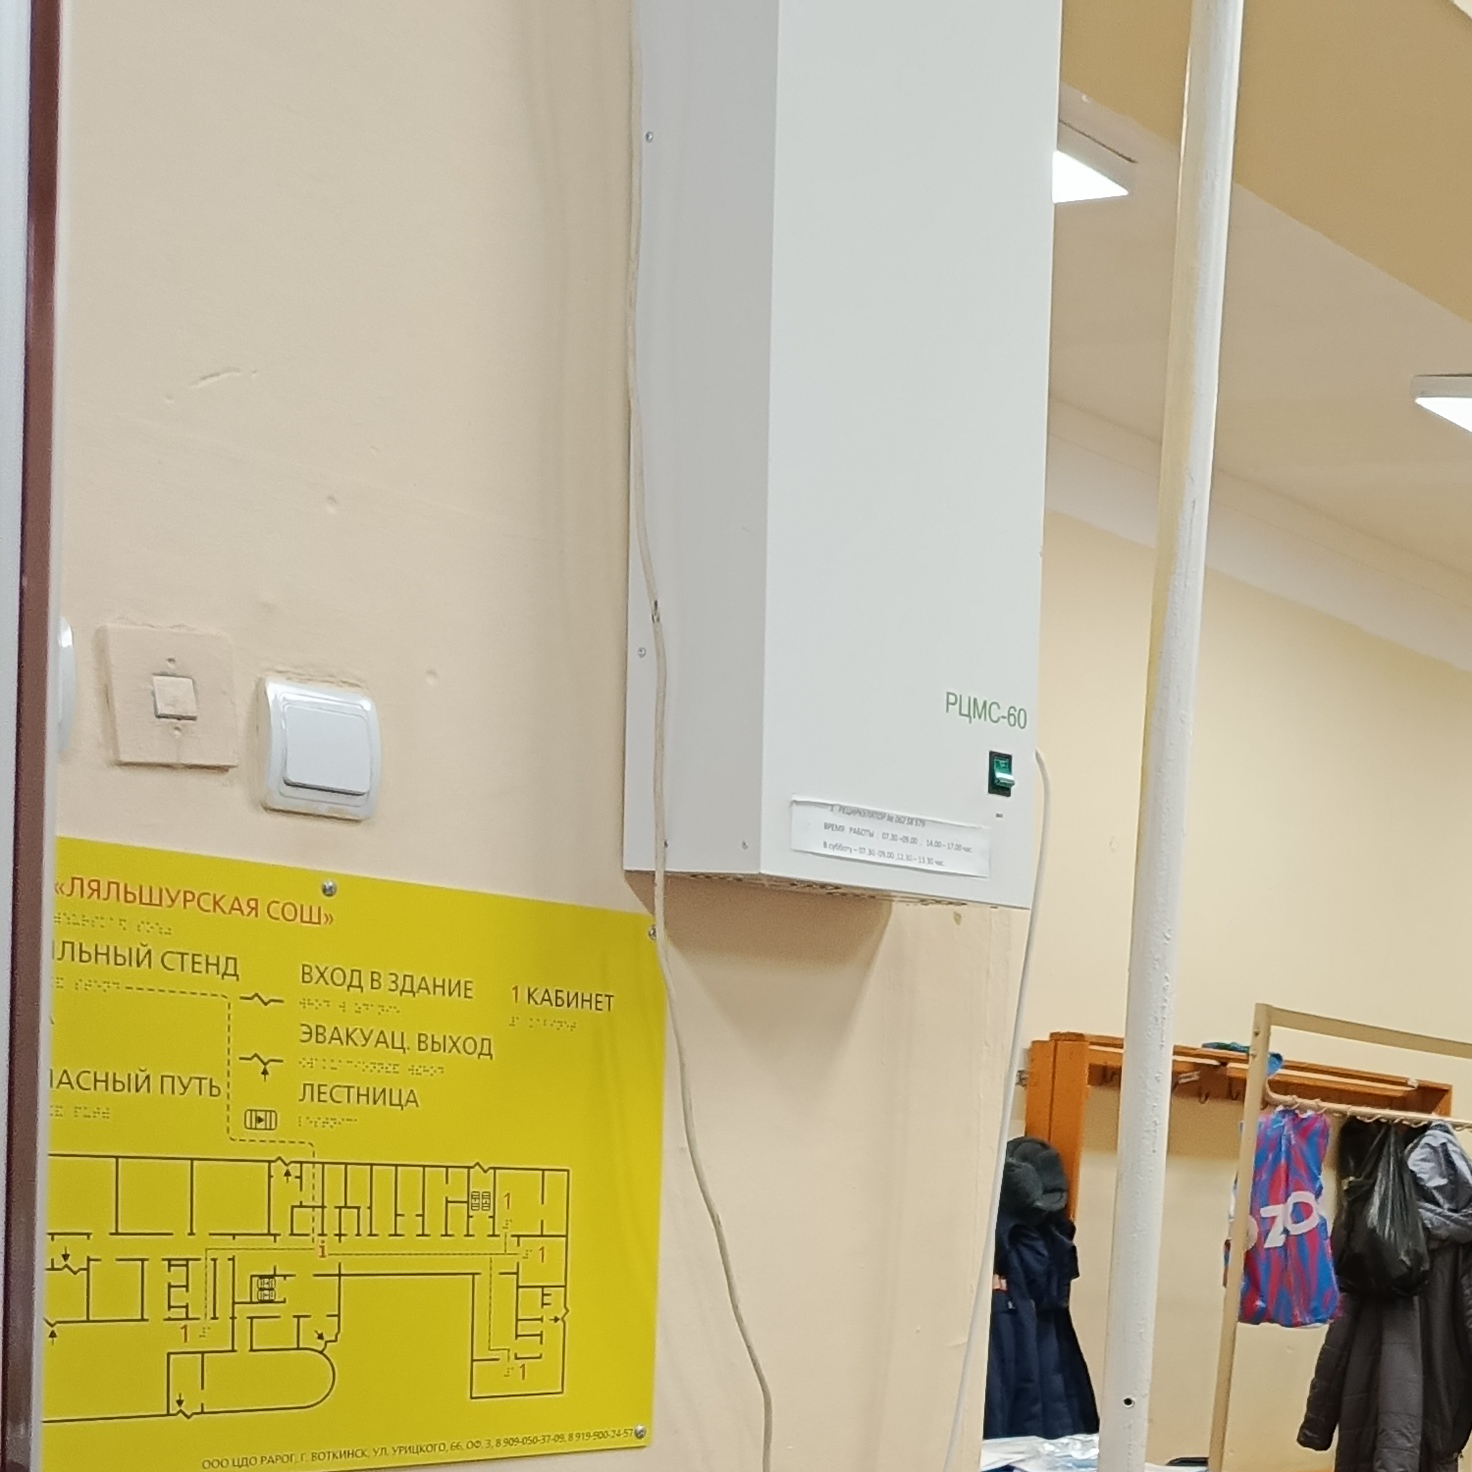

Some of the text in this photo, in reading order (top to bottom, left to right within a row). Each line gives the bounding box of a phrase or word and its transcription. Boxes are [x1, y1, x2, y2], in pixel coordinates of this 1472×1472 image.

[945, 691, 1028, 729] РЦМС-60
[823, 822, 845, 832] ВРЕМЯ
[849, 826, 874, 837] РАБОТЫ
[54, 876, 334, 926] «ЛЯЛЬШУРСКАЯ СОШ»
[51, 940, 240, 981] ЛЬНЫЙ СТЕНД
[300, 963, 474, 1000] ВХОД В ЗДАНИЕ
[511, 985, 615, 1012] 1 КАБИНЕТ
[299, 1023, 494, 1060] ЭВАКУАЦ. ВЫХОД
[50, 1067, 222, 1098] АСНЫЙ ПУТЬ
[298, 1083, 419, 1110] ЛЕСТНИЦА
[503, 1192, 512, 1210] 1
[538, 1246, 547, 1264] 1
[180, 1324, 189, 1343] 1
[519, 1364, 528, 1380] 1
[202, 1458, 229, 1470] ООО
[232, 1456, 258, 1469] ЦДО
